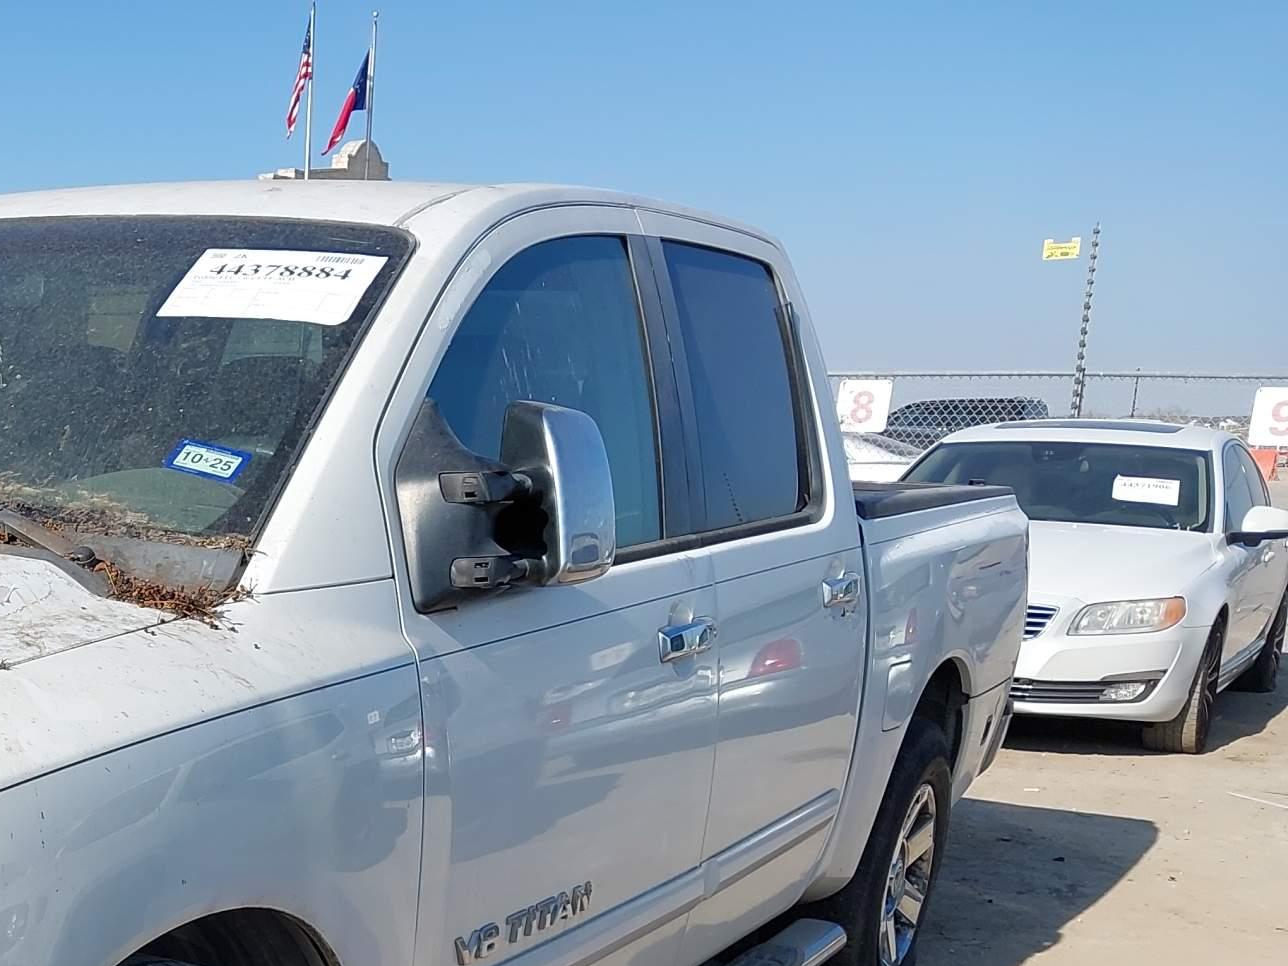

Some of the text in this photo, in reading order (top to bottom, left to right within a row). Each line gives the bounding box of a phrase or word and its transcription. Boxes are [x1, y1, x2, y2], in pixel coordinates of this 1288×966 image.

[210, 263, 352, 280] 44378884
[850, 390, 874, 424] 8
[454, 881, 592, 966] V8 TITAN
